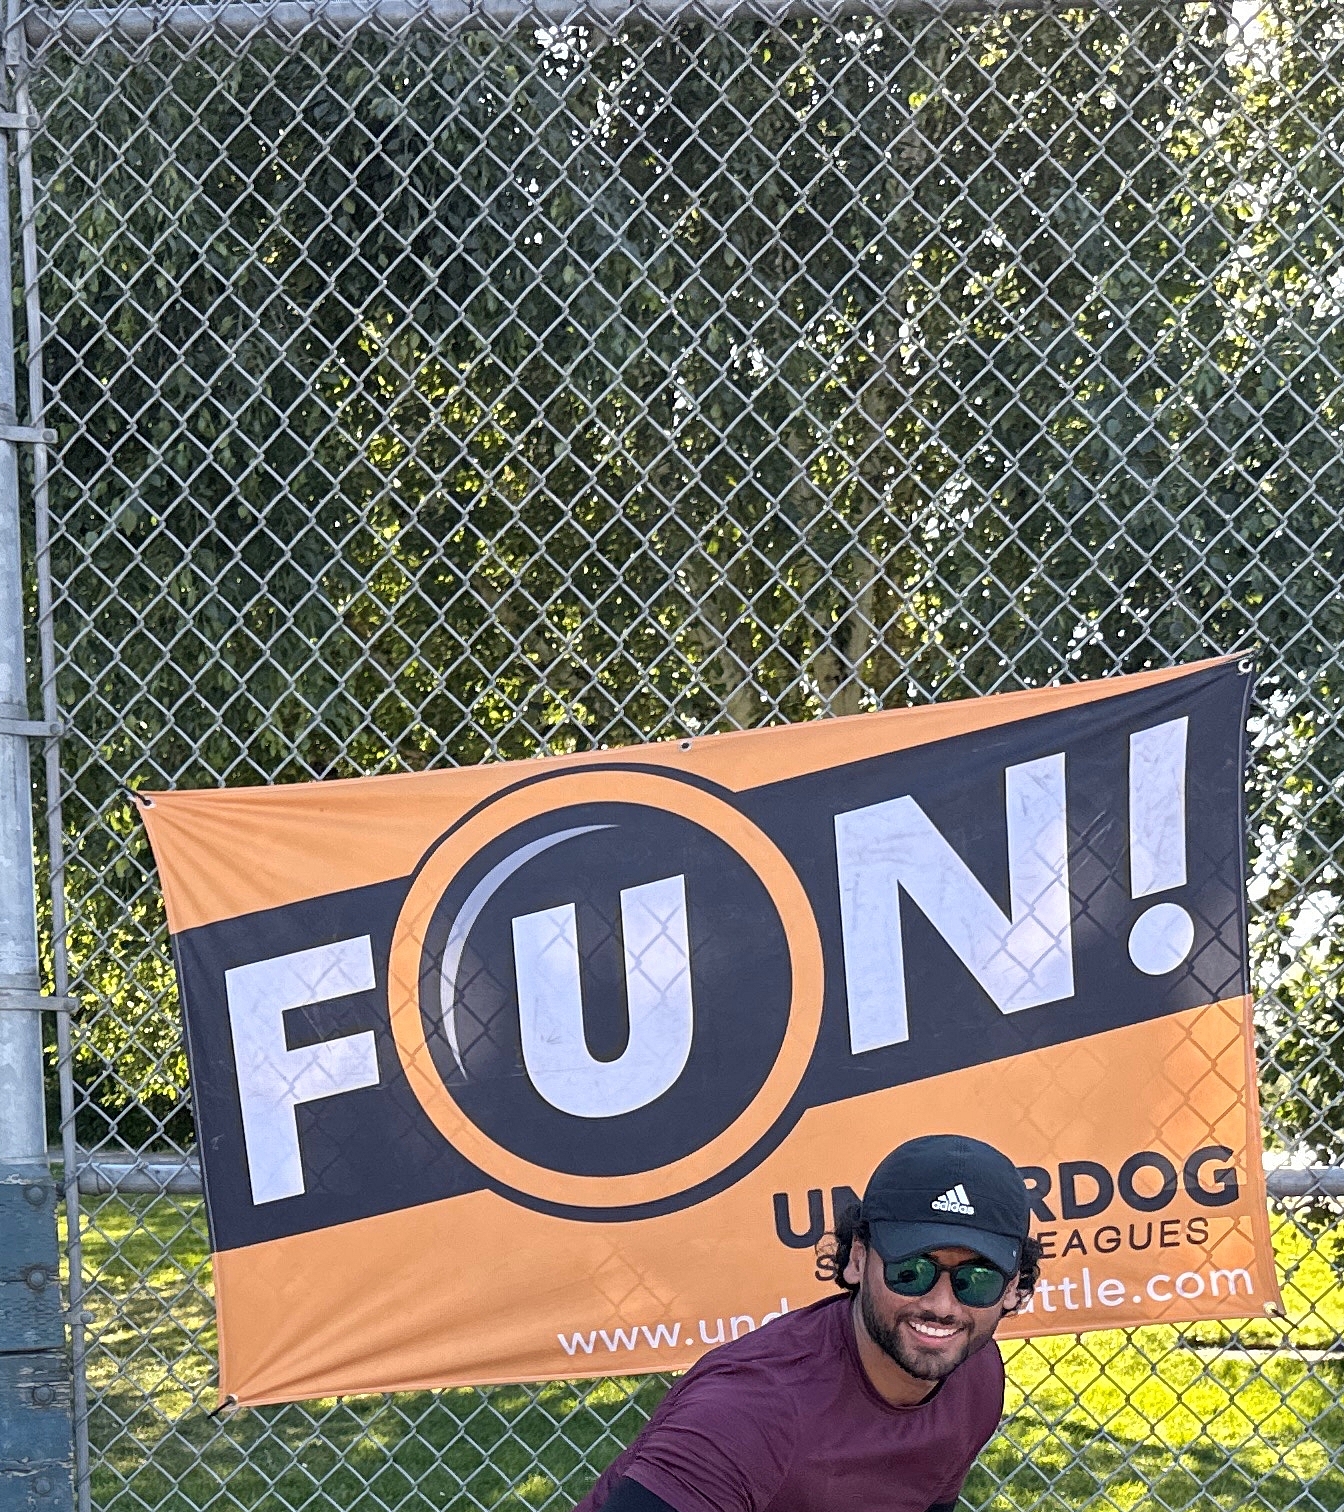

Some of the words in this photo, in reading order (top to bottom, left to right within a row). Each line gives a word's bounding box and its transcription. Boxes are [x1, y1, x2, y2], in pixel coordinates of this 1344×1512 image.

[223, 715, 1195, 1206] FUN!
[772, 1144, 1240, 1249] URDOG
[931, 1199, 975, 1216] adidas
[1035, 1216, 1209, 1259] EAGUES
